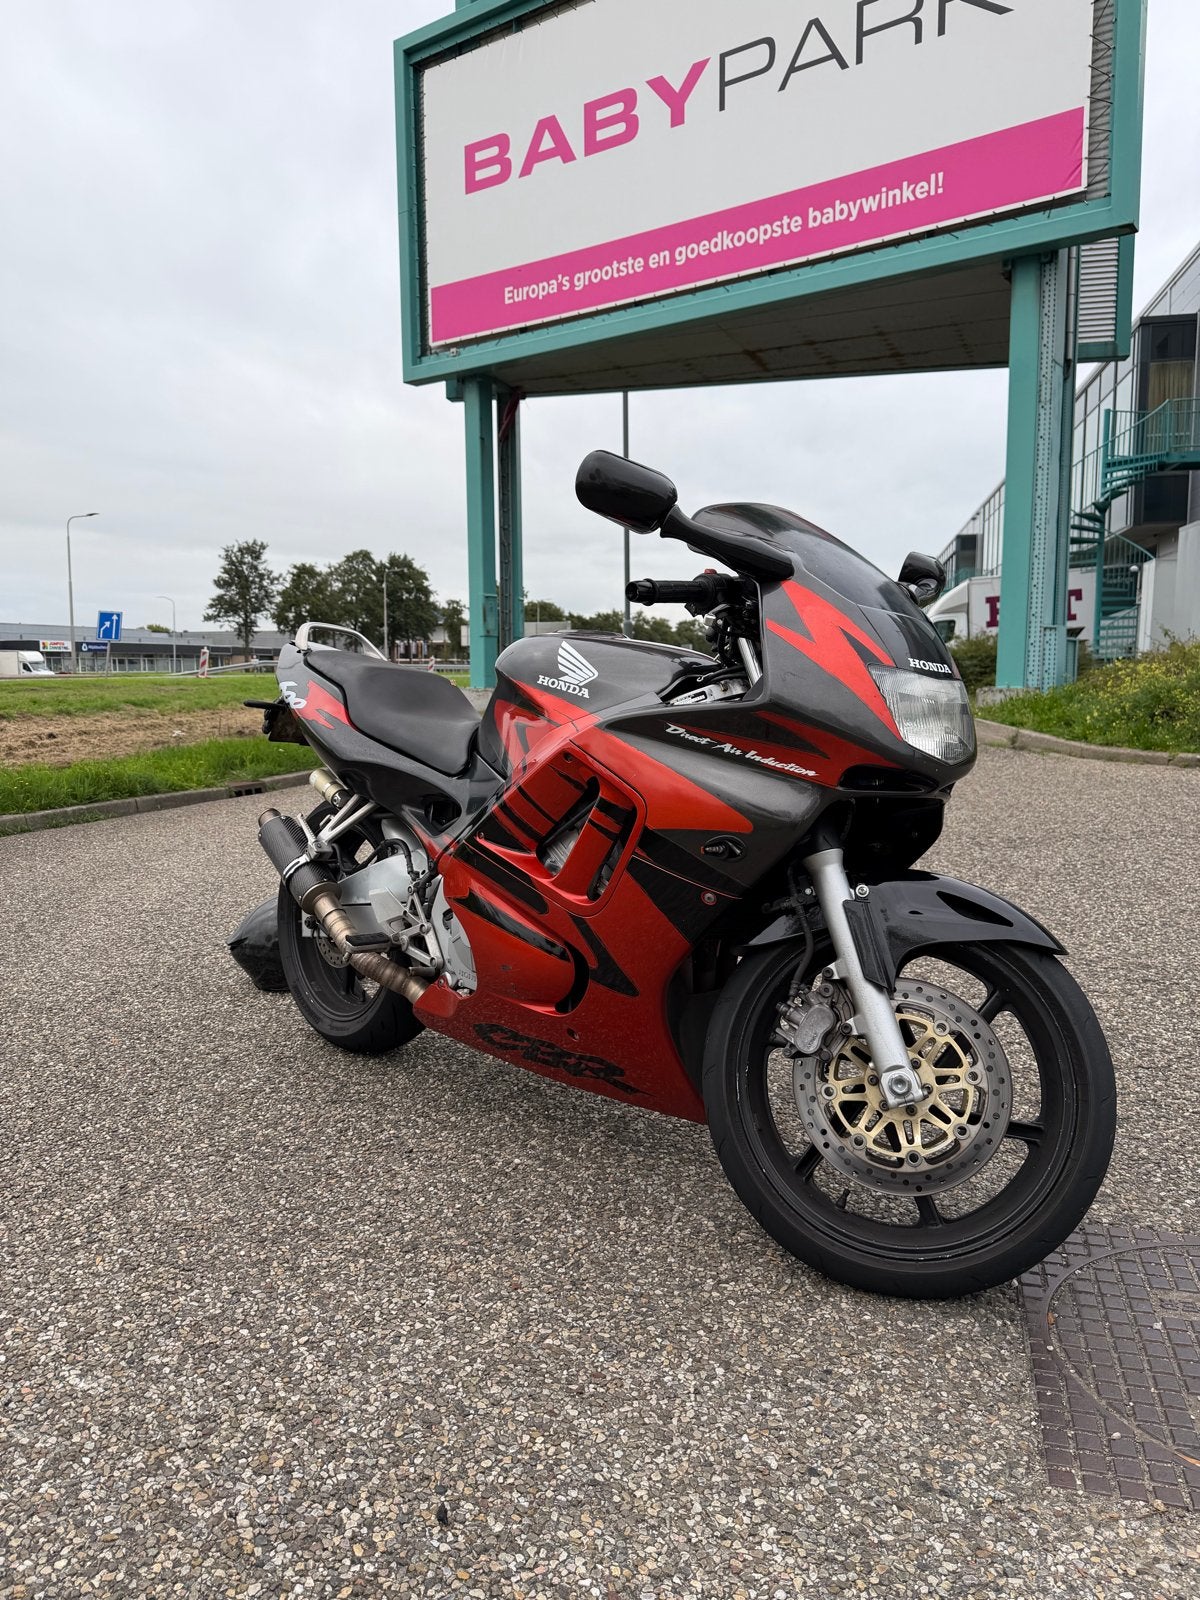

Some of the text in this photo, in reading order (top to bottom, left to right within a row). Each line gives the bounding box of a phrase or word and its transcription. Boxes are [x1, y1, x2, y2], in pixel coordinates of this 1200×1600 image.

[504, 171, 945, 305] Europa’s grootste en goedkoopste babywinkel!
[908, 657, 952, 674] HONDA
[537, 674, 590, 699] HONDA
[664, 722, 819, 777] Direct Air Induction
